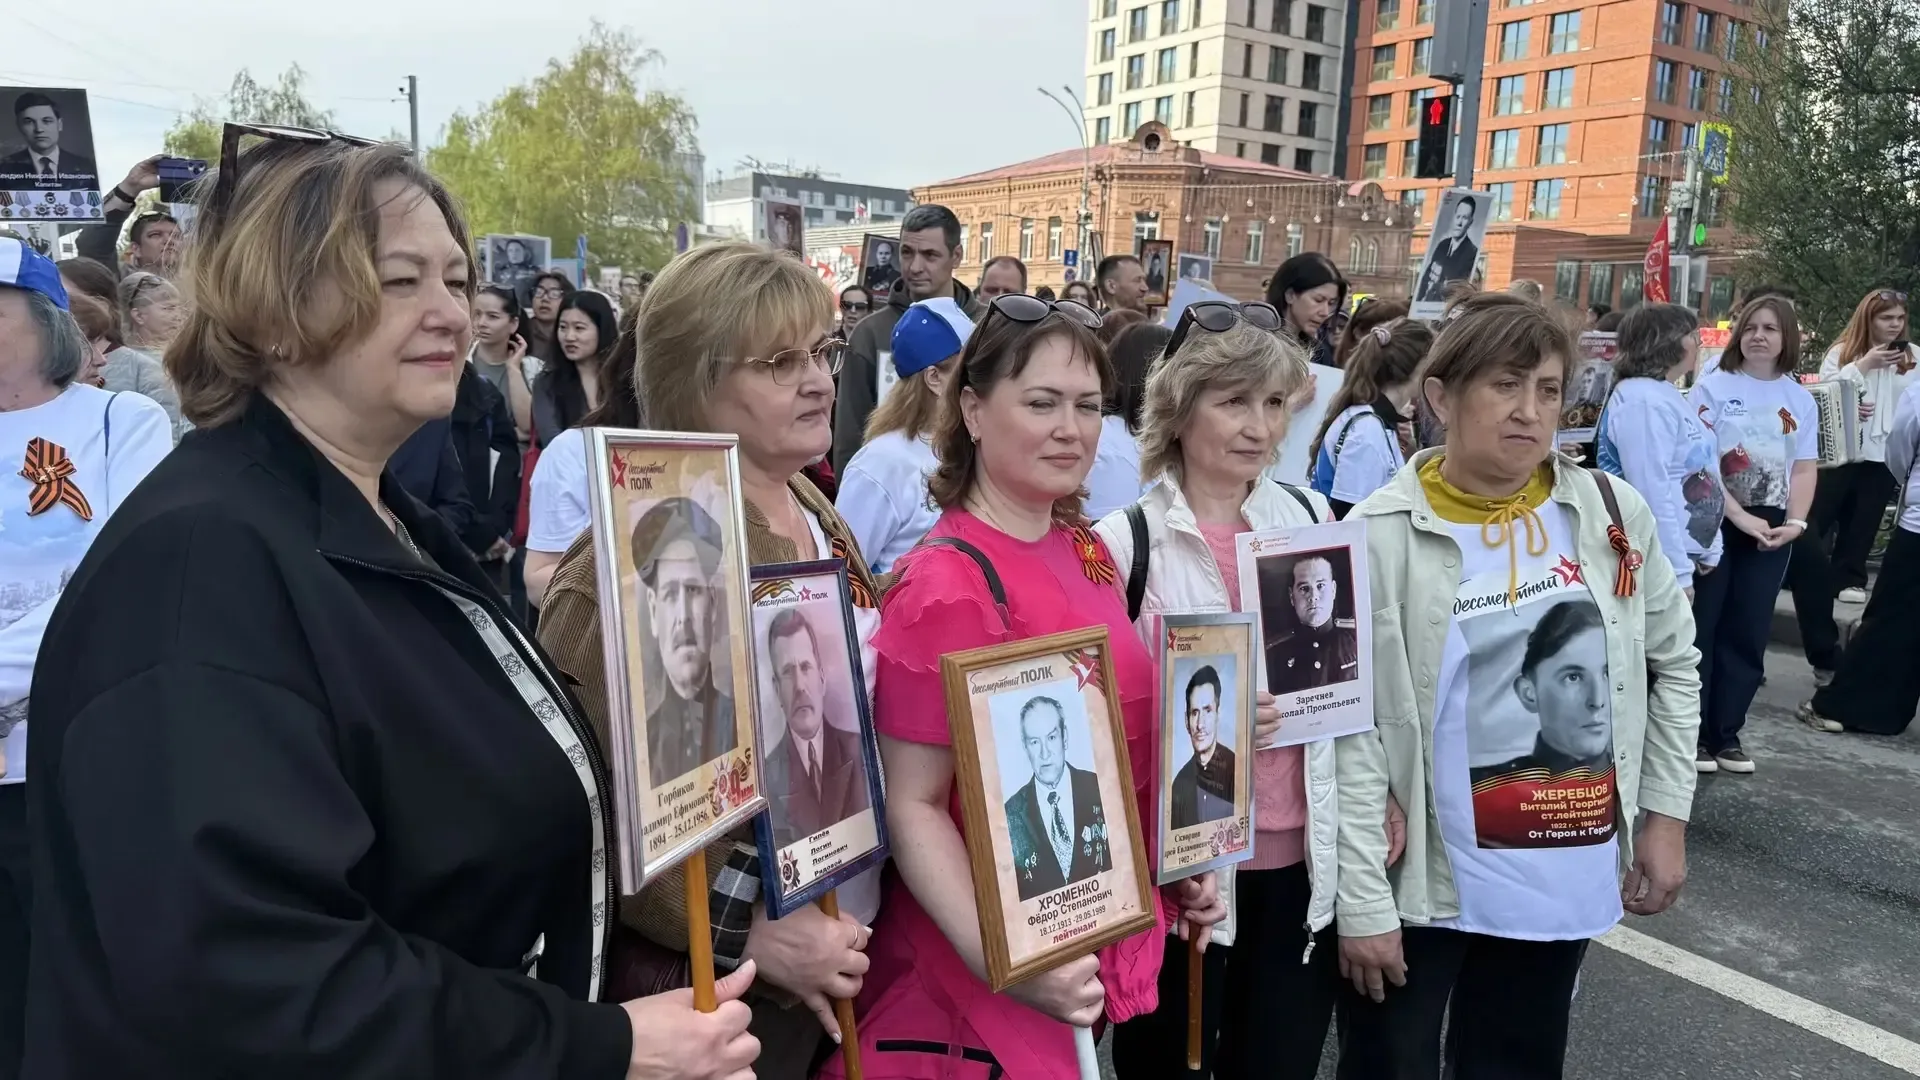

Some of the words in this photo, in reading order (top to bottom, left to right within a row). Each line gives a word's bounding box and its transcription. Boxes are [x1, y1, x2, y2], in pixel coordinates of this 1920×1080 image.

[25, 172, 57, 180] Николай
[59, 172, 95, 180] Иванович
[630, 477, 652, 491] ПОЛК
[1177, 643, 1192, 652] ПОЛК
[1020, 665, 1053, 684] ПОЛК
[1296, 691, 1334, 705] Заречнев
[1279, 706, 1305, 719] колай
[1307, 696, 1361, 715] Прокопьевич
[1532, 783, 1608, 801] ЖЕРЕБЦОВ
[1520, 801, 1567, 811] Виталий
[1541, 807, 1606, 820] ст.лейтенант
[641, 812, 672, 837] адимир
[649, 834, 667, 852] 1894
[1528, 830, 1543, 839] От
[1546, 830, 1577, 840] Героя
[1580, 829, 1586, 837] к
[814, 859, 843, 877] Рядовой
[1038, 879, 1100, 912] ХРОМЕНКО
[1027, 910, 1059, 927] Фёдор
[1060, 889, 1113, 914] Степанович
[1039, 918, 1072, 937] 18.12.1913
[1052, 919, 1098, 944] лейтенант
